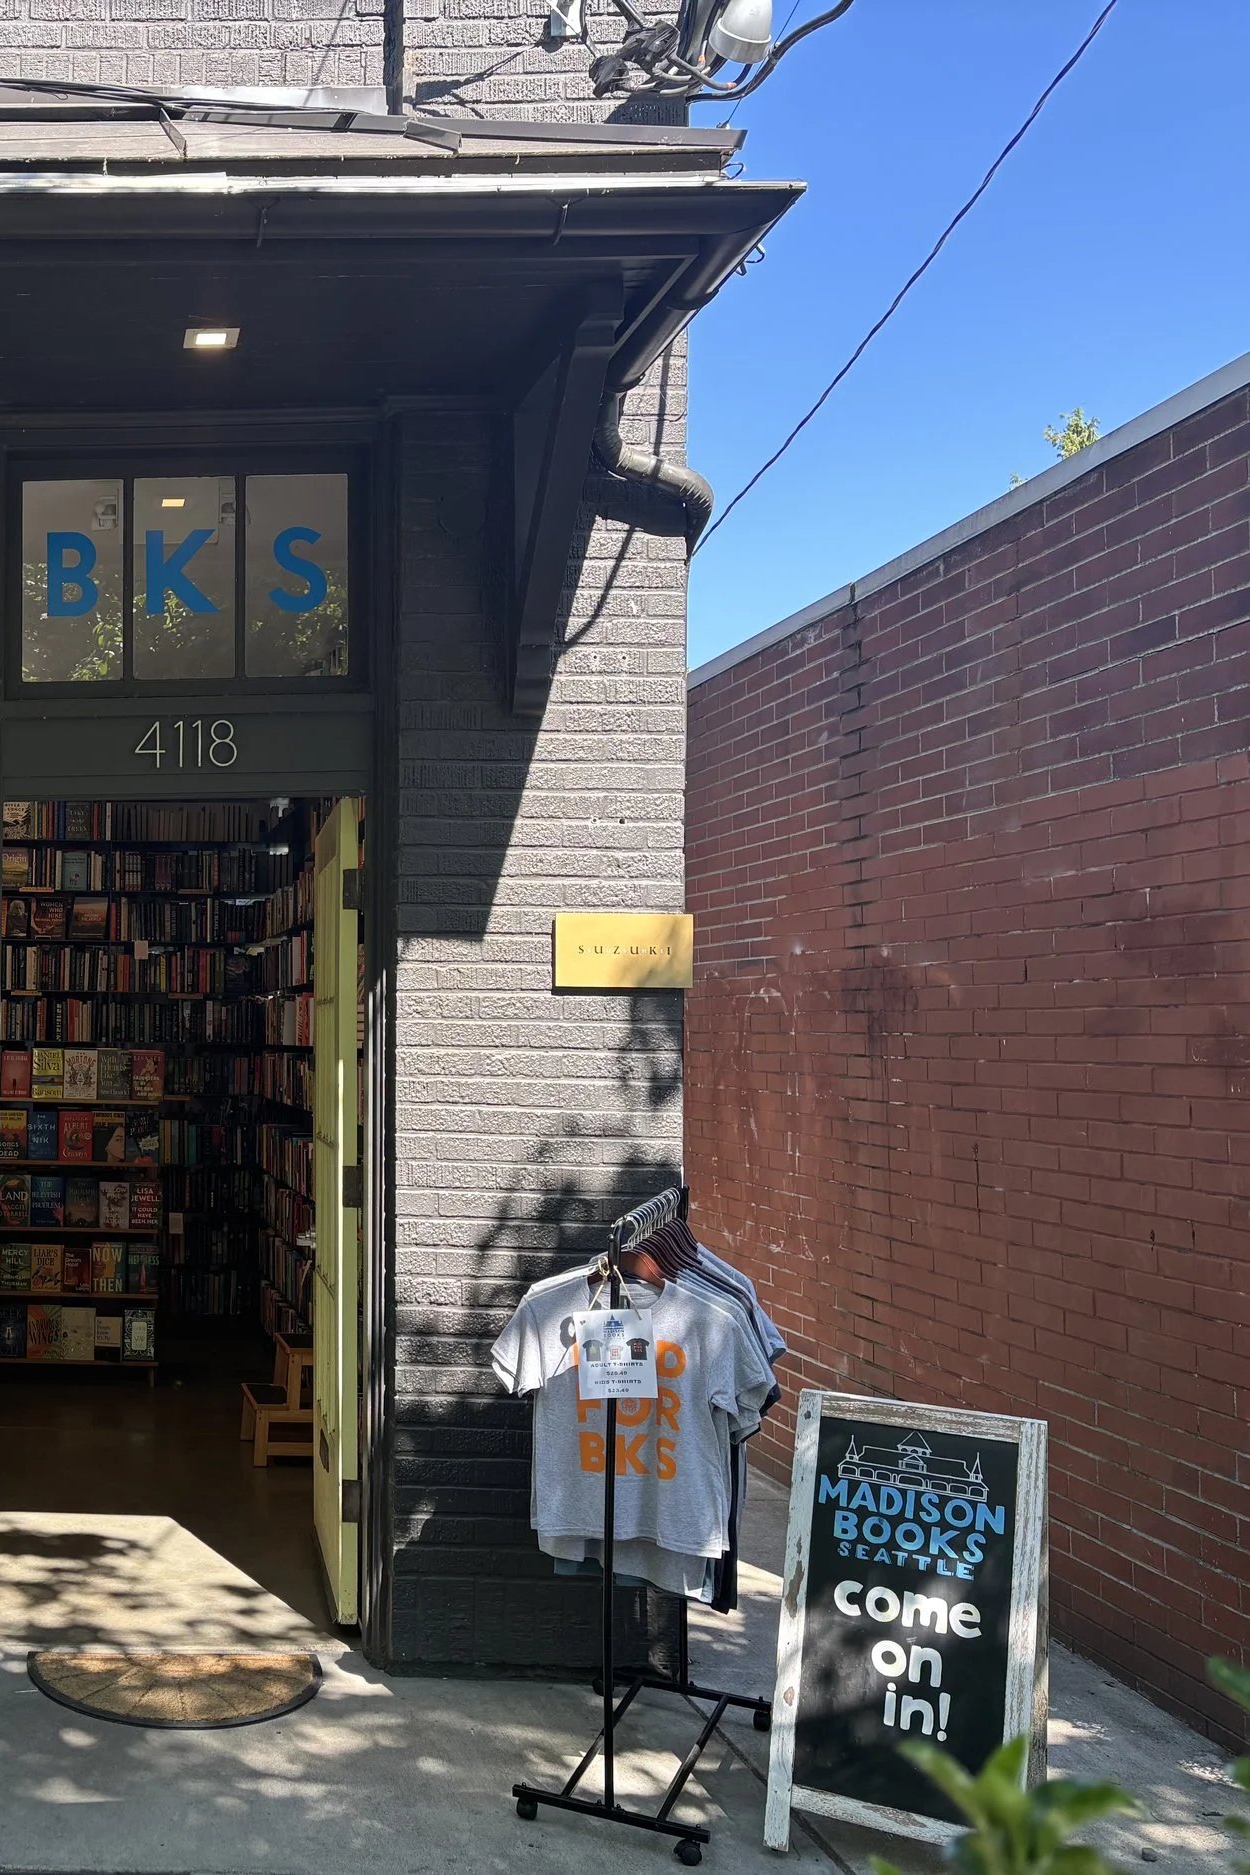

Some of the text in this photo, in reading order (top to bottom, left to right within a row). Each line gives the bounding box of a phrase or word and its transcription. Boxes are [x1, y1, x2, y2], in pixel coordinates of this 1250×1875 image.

[47, 527, 328, 617] BKS
[134, 720, 238, 769] 4118
[2, 854, 27, 863] Origin
[578, 945, 671, 956] SUZUKI
[34, 1050, 61, 1059] DANIEL
[101, 1055, 117, 1063] With
[33, 1059, 60, 1072] Silva
[100, 1063, 125, 1072] Friends
[28, 1123, 56, 1131] SIXTH
[0, 1192, 29, 1201] LAND
[34, 1248, 59, 1257] LIAR'S
[93, 1247, 123, 1262] NOW
[6, 1257, 23, 1265] HILL
[37, 1257, 55, 1266] DICE
[93, 1278, 123, 1292] THEN
[29, 1330, 60, 1344] WINGS
[578, 1431, 678, 1480] BKS
[818, 1474, 1005, 1534] MADISON
[833, 1510, 986, 1563] BOOKS
[838, 1541, 975, 1580] SEATTLE
[834, 1580, 982, 1638] come
[871, 1640, 942, 1688] on
[883, 1682, 950, 1742] in!
